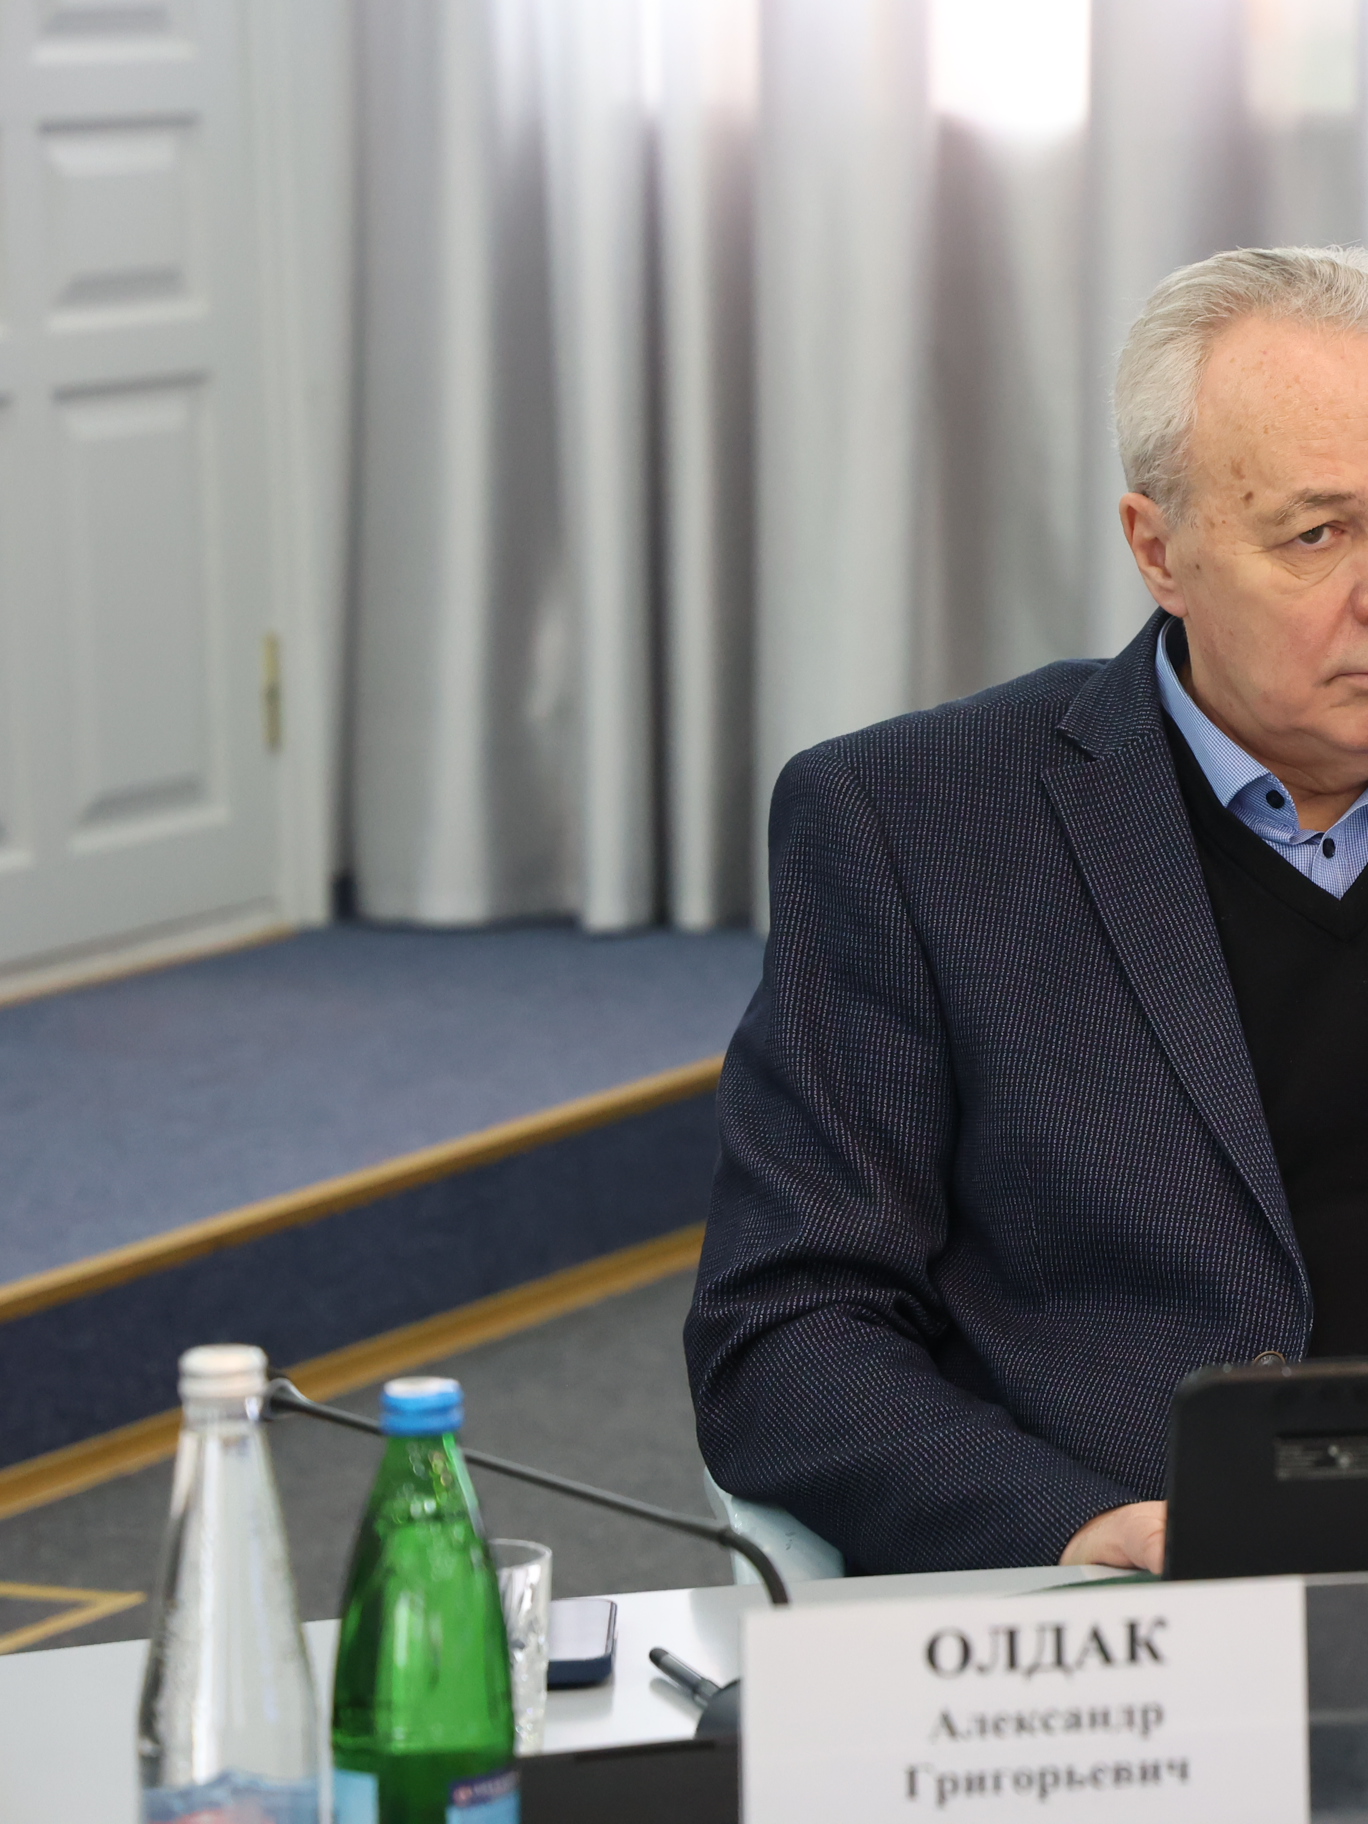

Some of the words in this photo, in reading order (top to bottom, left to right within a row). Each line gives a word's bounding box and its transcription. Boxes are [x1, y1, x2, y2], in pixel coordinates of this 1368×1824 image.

[923, 1616, 1168, 1680] ОЛДАК
[932, 1702, 1165, 1743] Александр
[905, 1757, 1190, 1809] Григорьевич
